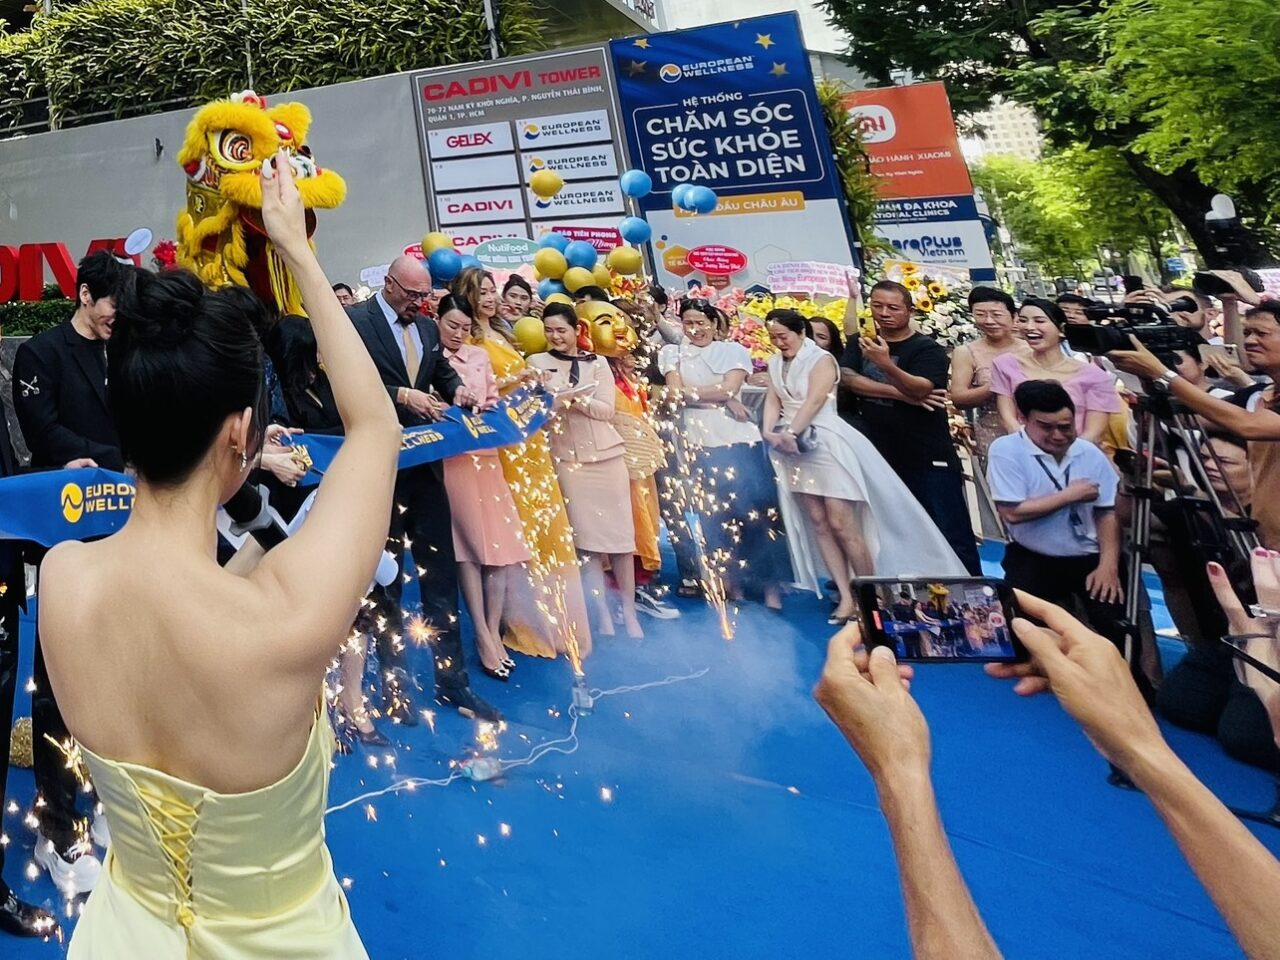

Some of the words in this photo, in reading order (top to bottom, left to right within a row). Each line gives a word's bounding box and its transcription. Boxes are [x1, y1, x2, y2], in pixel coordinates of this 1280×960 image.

[682, 56, 753, 71] EUROPEAN
[683, 63, 754, 77] WELLNESS
[424, 70, 532, 101] CADIVI
[538, 65, 602, 85] TOWER
[682, 96, 698, 107] HỆ
[701, 92, 743, 104] THỐNG
[542, 119, 601, 131] EUROPEAN
[646, 109, 727, 136] CHĂM
[733, 102, 794, 126] SÓC
[542, 125, 601, 136] WELLNESS
[446, 131, 493, 148] GELEX
[651, 137, 708, 161] SỨC
[714, 126, 802, 155] KHỎE
[547, 154, 606, 165] EUROPEAN
[917, 151, 952, 160] XIAOMI
[547, 160, 608, 171] WELLNESS
[655, 160, 729, 183] TOÀN
[736, 153, 806, 178] DIỆN
[553, 190, 613, 200] EUROPEAN
[553, 196, 614, 206] WELLNESS
[447, 200, 513, 214] CADIVI
[743, 198, 777, 210] CHÂU
[922, 200, 958, 210] KHOA
[912, 209, 950, 217] CLINICS
[487, 242, 529, 252] Nutifood
[86, 483, 136, 497] EURO
[85, 497, 136, 512] WELL
